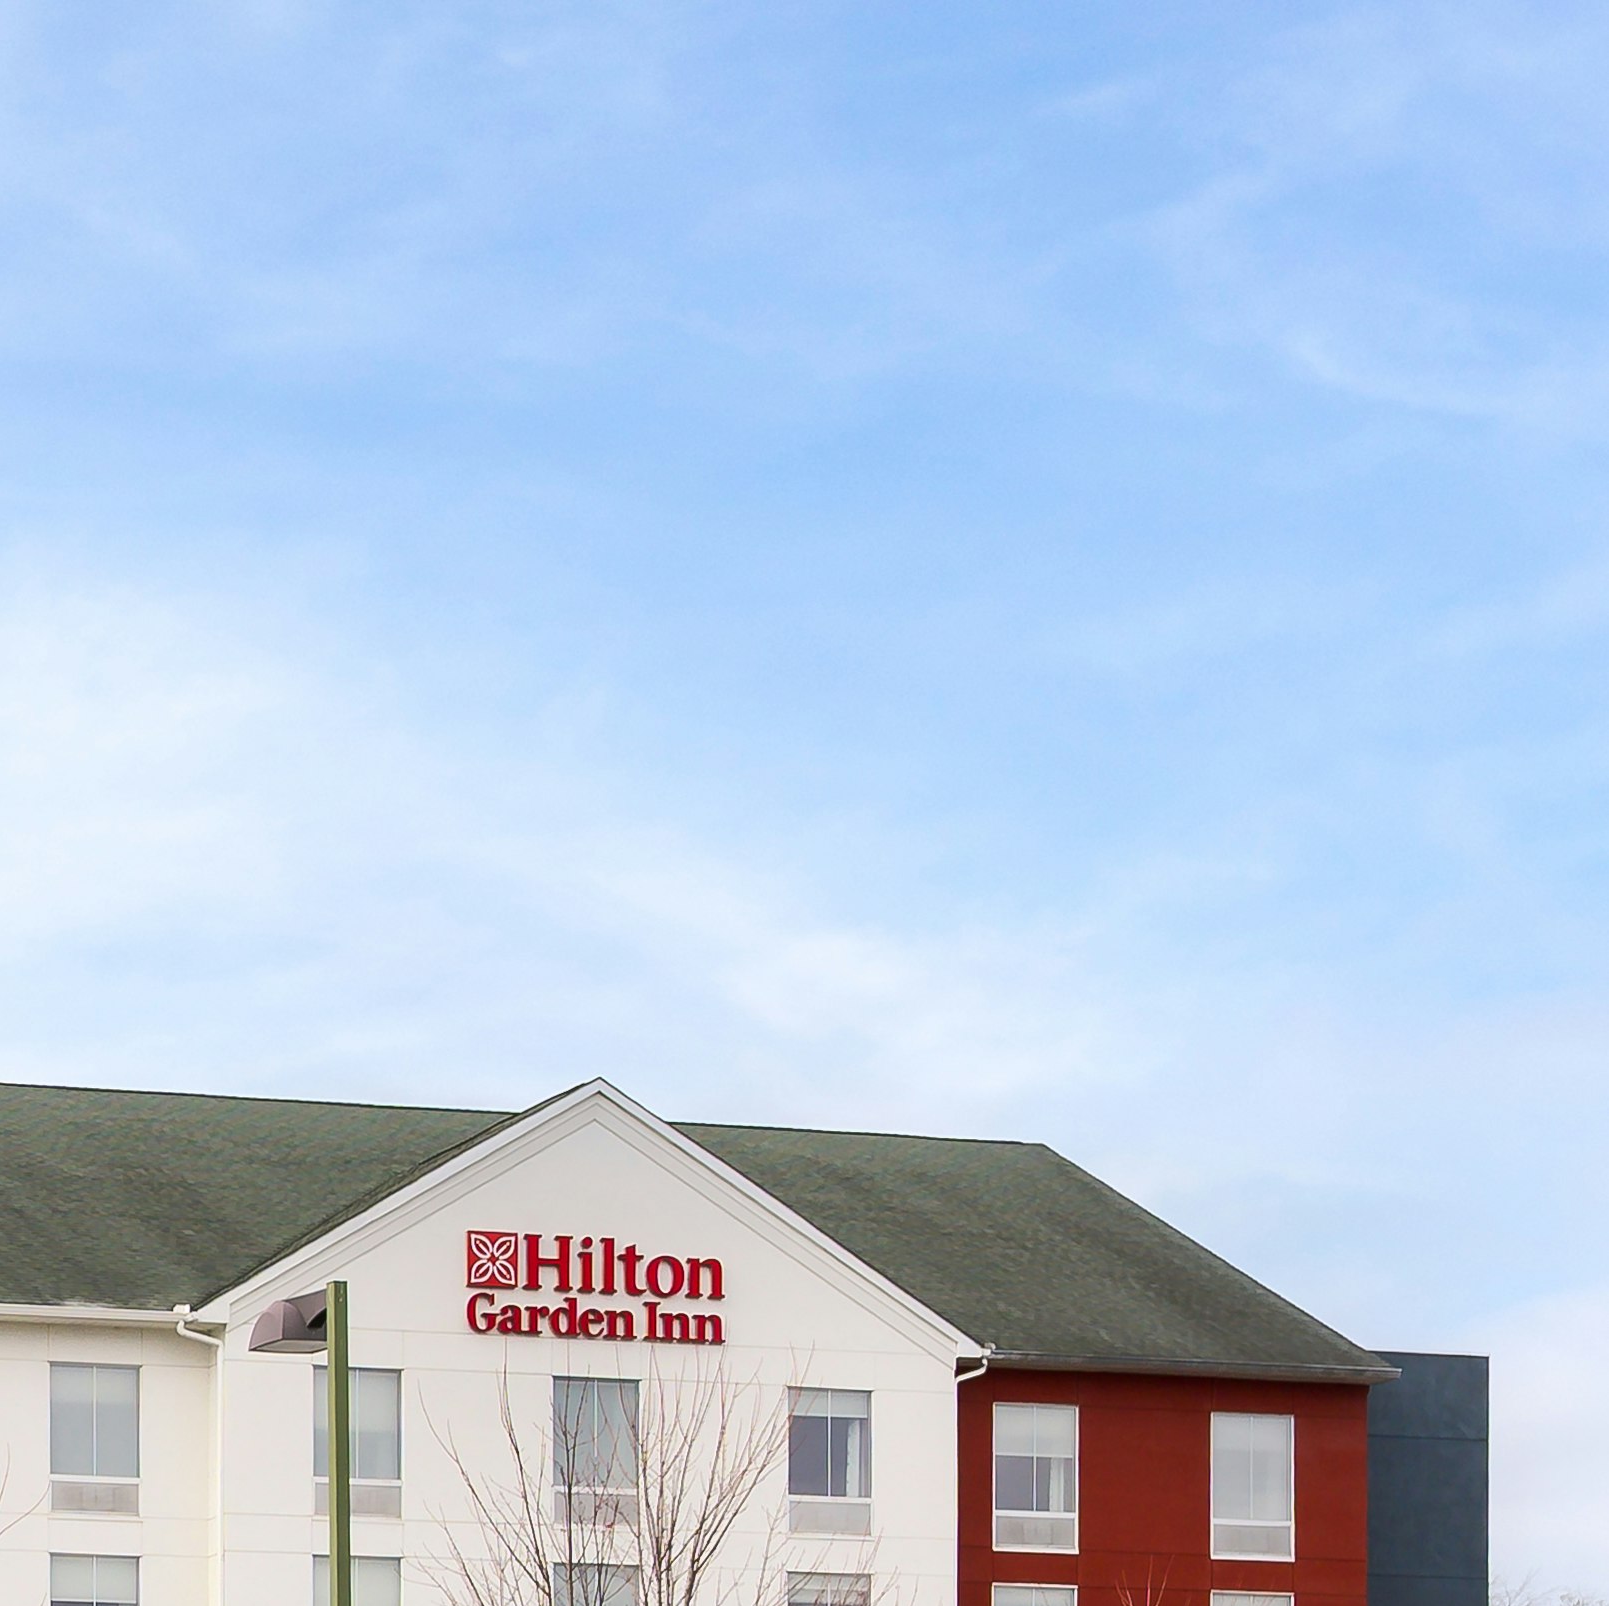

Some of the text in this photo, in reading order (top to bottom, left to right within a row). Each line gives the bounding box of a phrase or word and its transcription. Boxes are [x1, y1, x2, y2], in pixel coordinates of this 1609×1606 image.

[521, 1233, 725, 1300] Hilton
[466, 1292, 726, 1345] Garden Inn
